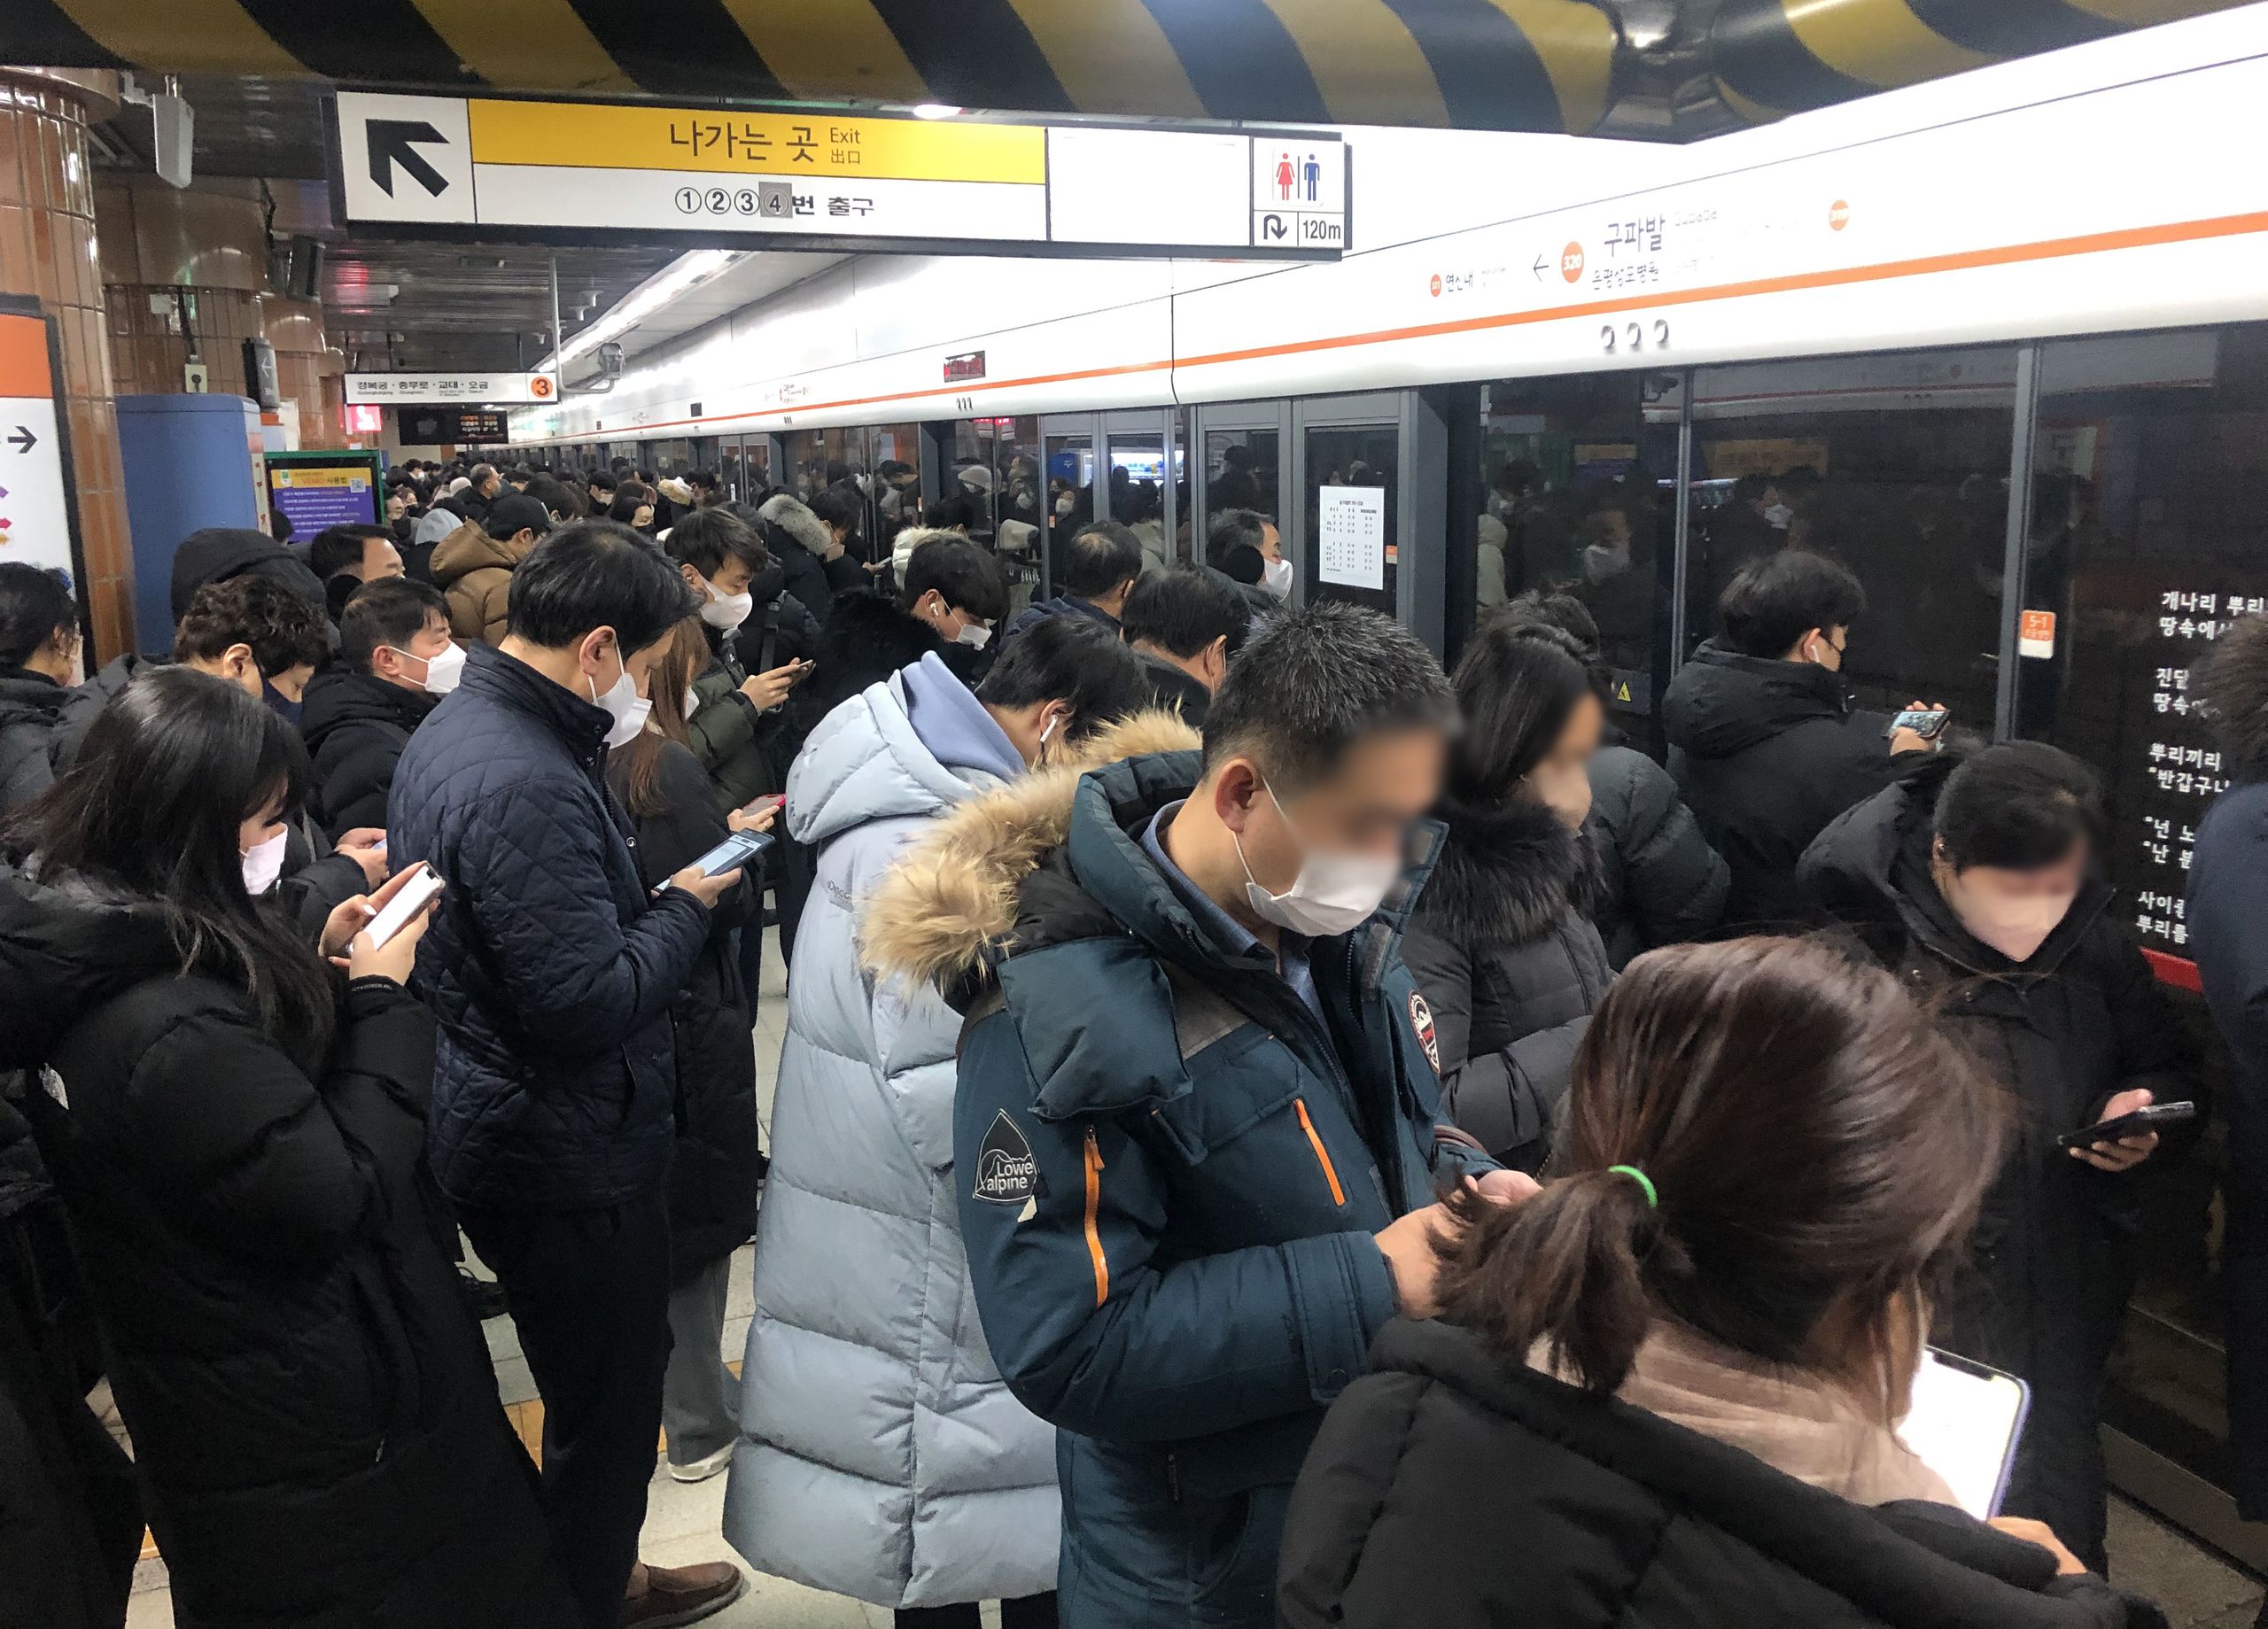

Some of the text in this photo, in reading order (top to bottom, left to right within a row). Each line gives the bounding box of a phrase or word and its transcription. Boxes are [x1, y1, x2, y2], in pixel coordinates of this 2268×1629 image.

[669, 120, 819, 163] 나가는 곳
[829, 127, 861, 145] Exit
[830, 148, 861, 166] 出口
[827, 196, 875, 217] 출구
[1302, 219, 1341, 240] 120m
[1604, 213, 1666, 258] 구파발
[1445, 270, 1474, 293] 연신내
[357, 381, 488, 390] 경복궁 충무로 교대 오금
[535, 378, 549, 397] 3
[2161, 591, 2217, 614] 개나리
[2030, 615, 2047, 628] 5-1
[2149, 742, 2222, 772] 뿌리끼리
[2136, 914, 2188, 944] 뿌리를
[997, 1161, 1034, 1177] Lowe
[986, 1175, 1029, 1195] alpine
